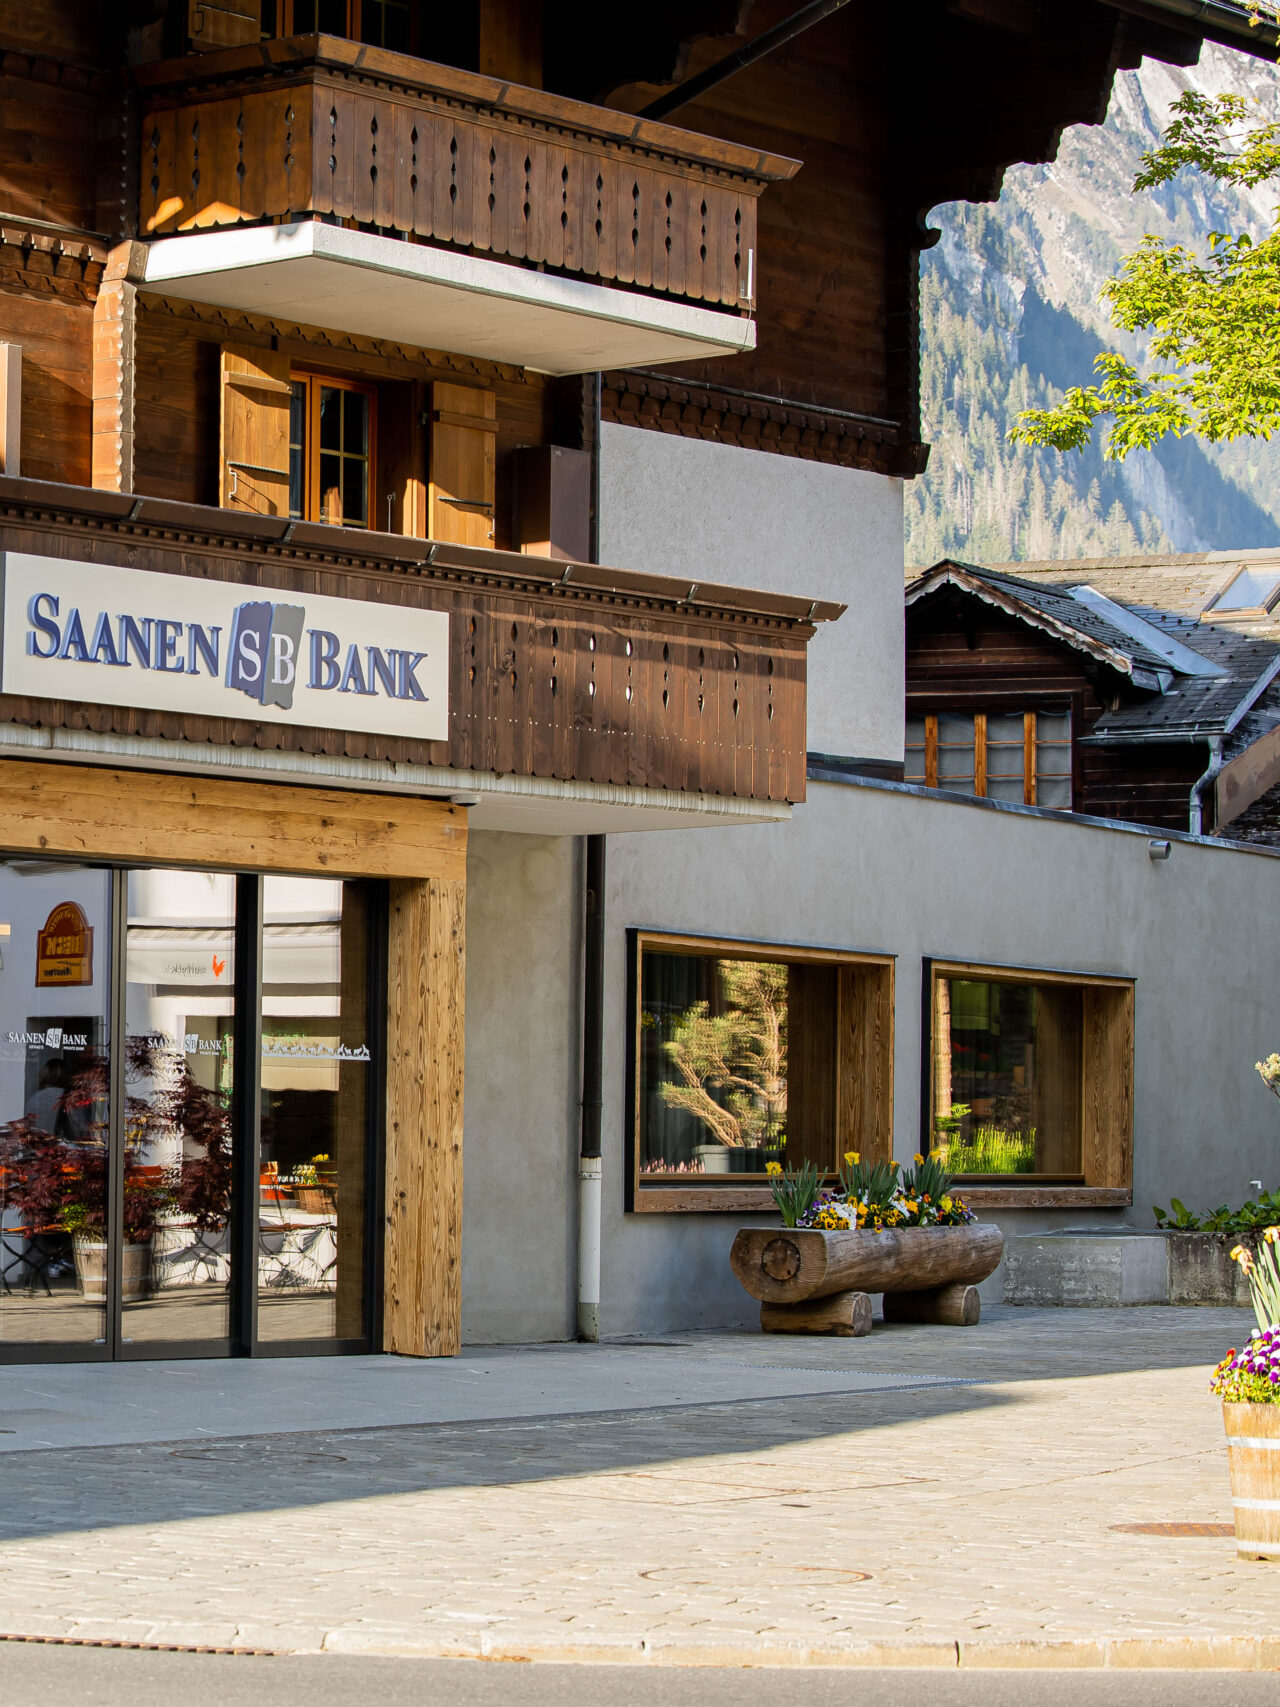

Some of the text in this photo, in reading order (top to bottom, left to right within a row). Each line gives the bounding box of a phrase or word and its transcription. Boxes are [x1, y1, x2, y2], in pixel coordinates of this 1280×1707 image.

[26, 592, 223, 678] SAANEN
[306, 629, 429, 702] BANK
[8, 1031, 45, 1044] SAANEN
[62, 1034, 88, 1046] BANK
[198, 1039, 223, 1051] BANK
